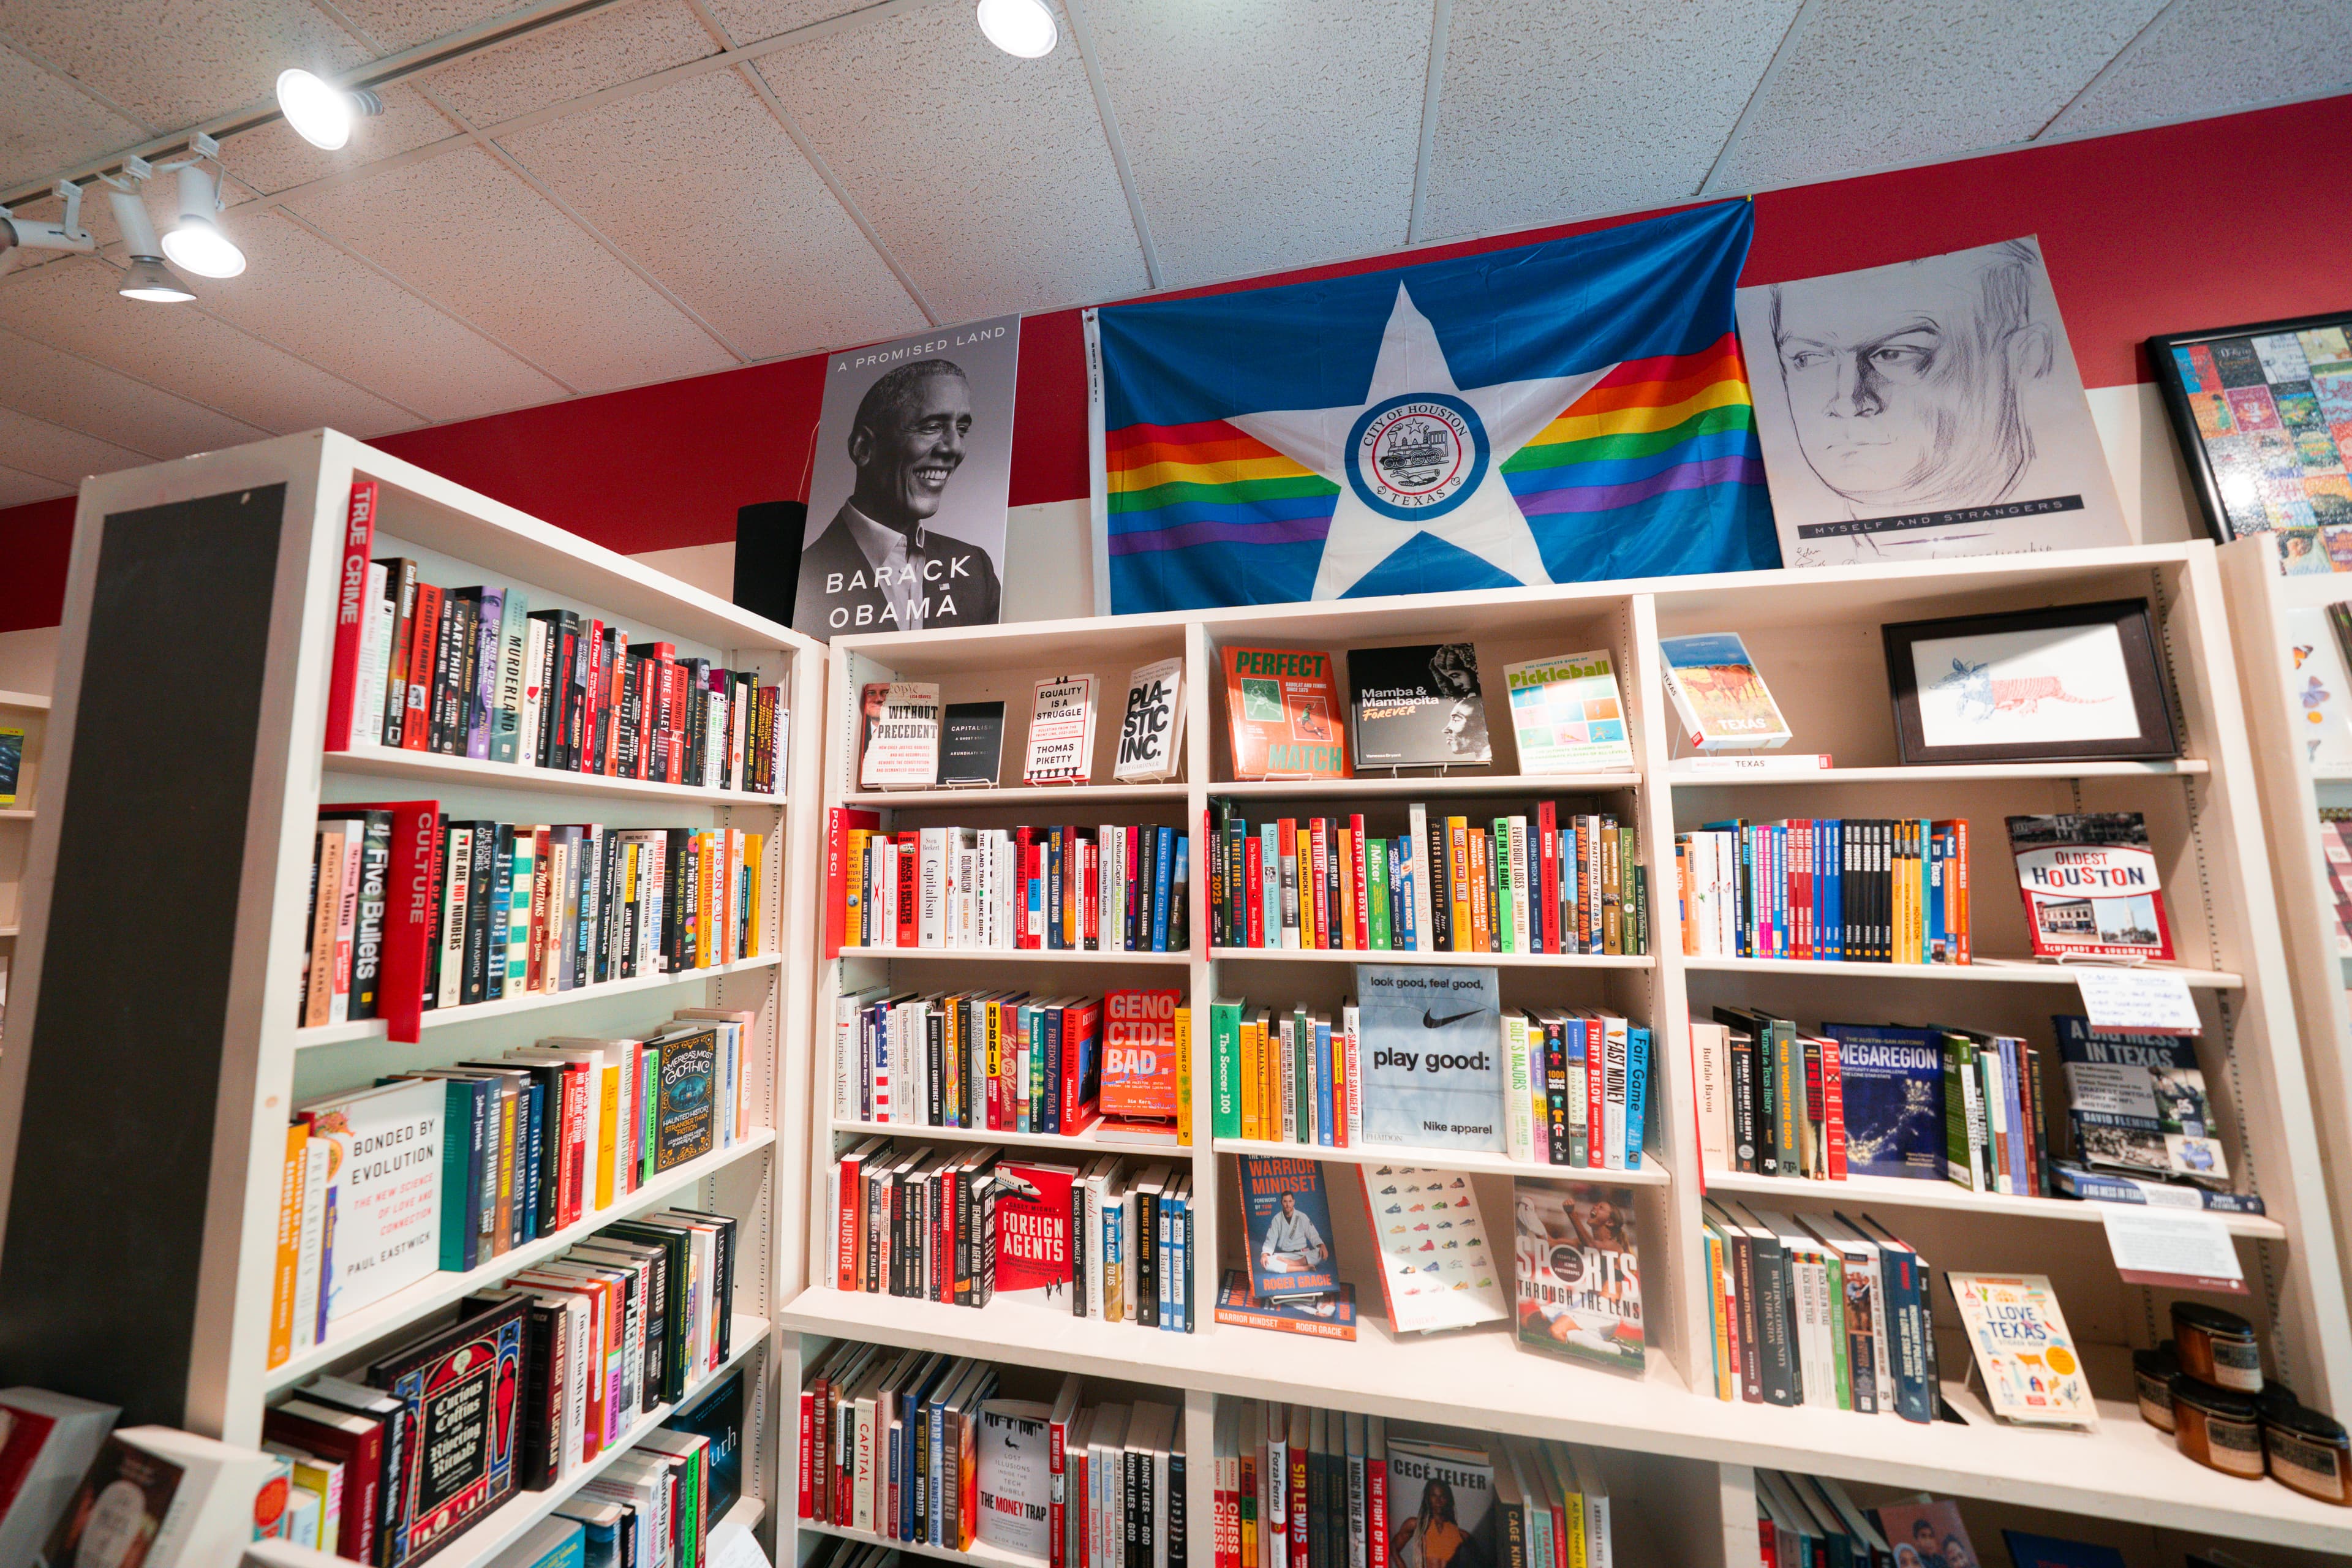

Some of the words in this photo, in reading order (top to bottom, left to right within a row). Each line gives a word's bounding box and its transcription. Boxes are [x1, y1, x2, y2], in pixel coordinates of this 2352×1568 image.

[837, 362, 848, 372] A
[856, 339, 948, 368] PROMISED
[956, 326, 1005, 346] LAND
[1363, 419, 1386, 447] CITY
[1387, 409, 1403, 420] OF
[1408, 405, 1468, 437] HOUSTON
[1390, 489, 1446, 506] TEXAS
[349, 487, 371, 547] TRUE
[1815, 521, 1883, 535] MYSELF
[1896, 516, 1931, 526] AND
[1943, 500, 2064, 522] STRANGERS
[826, 555, 971, 594] BARACK
[340, 554, 364, 626] CRIME
[829, 594, 957, 628] OBAMA
[1235, 651, 1325, 677] PERFECT
[1509, 660, 1610, 688] Pickleball
[502, 635, 522, 733] MURDERLAND
[662, 669, 673, 699] BONE
[1039, 686, 1082, 699] EQUALITY
[1127, 680, 1172, 714] PLA-
[1362, 687, 1414, 698] Mamba
[1415, 686, 1427, 696] &
[1663, 673, 1677, 696] TEXAS
[889, 706, 938, 720] WITHOUT
[1036, 708, 1082, 720] STRUGGLE
[1362, 695, 1439, 707] Mambacita
[660, 701, 671, 733] VALLEY
[878, 725, 937, 739] PRECEDENT
[1124, 704, 1169, 737] STIC
[1717, 718, 1766, 730] TEXAS
[1036, 755, 1072, 765] PIKETTY
[1037, 744, 1074, 754] THOMAS
[1120, 734, 1161, 764] INC.
[1268, 744, 1343, 771] MATCH
[1512, 827, 1524, 865] EVERYBODY
[363, 848, 388, 896] Five
[409, 813, 432, 924] CULTURE
[961, 856, 971, 893] COLONIALISM
[1232, 864, 1241, 887] KINGS
[1357, 867, 1363, 878] OF
[1370, 849, 1382, 882] Mixer
[1513, 869, 1525, 889] LOSES
[923, 860, 938, 919] Capitalism
[1212, 875, 1222, 905] 2025
[356, 902, 385, 979] Bullets
[1370, 977, 1393, 986] look
[1396, 978, 1427, 989] good,
[1430, 979, 1449, 989] feel
[1453, 980, 1483, 990] good,
[1109, 995, 1175, 1019] GENO
[1108, 1022, 1174, 1047] CIDE
[1219, 1033, 1229, 1054] The
[1589, 1028, 1600, 1065] THIRTY
[697, 1050, 713, 1059] MOST
[838, 1033, 846, 1070] Furious
[1348, 1034, 1357, 1079] SANCTIONED
[1374, 1047, 1419, 1071] play
[1425, 1051, 1490, 1072] good:
[1607, 1039, 1625, 1065] FAST
[1634, 1038, 1647, 1065] Fair
[1703, 1048, 1713, 1081] Buffalo
[1839, 1044, 1937, 1069] MEGAREGION
[2085, 1042, 2108, 1062] IN
[2109, 1045, 2174, 1069] TEXAS
[665, 1061, 710, 1085] GOTHIC
[1219, 1055, 1230, 1093] Soccer
[1591, 1069, 1600, 1105] BELOW
[1607, 1067, 1625, 1105] MONEY
[1782, 1065, 1790, 1101] WOMEN
[837, 1073, 846, 1105] Minds
[1349, 1079, 1358, 1116] SAVAGERY
[1630, 1069, 1645, 1112] Game
[1704, 1085, 1713, 1113] Bayou
[1221, 1095, 1231, 1114] 100
[1423, 1121, 1447, 1131] Nike
[1451, 1125, 1492, 1135] apparel
[2083, 1112, 2113, 1125] DAVID
[2114, 1116, 2158, 1129] FLEMING
[353, 1126, 413, 1157] BONDED
[420, 1118, 435, 1136] BY
[1784, 1123, 1792, 1150] GOOD
[352, 1144, 434, 1186] EVOLUTION
[1249, 1159, 1316, 1177] WARRIOR
[1252, 1175, 1316, 1194] MINDSET
[841, 1208, 853, 1270] INJUSTICE
[1003, 1212, 1063, 1238] FOREIGN
[347, 1256, 375, 1276] PAUL
[380, 1231, 431, 1263] EASTWICK
[1003, 1232, 1063, 1262] AGENTS
[1516, 1235, 1639, 1297] SPORTS
[655, 1259, 665, 1313] PROGRESS
[1263, 1276, 1295, 1291] ROGER
[1298, 1275, 1332, 1287] GRACIE
[1518, 1280, 1573, 1306] THROUGH
[1580, 1292, 1602, 1311] THE
[1609, 1297, 1640, 1319] LENS
[1985, 1307, 1992, 1319] I
[1997, 1305, 2035, 1322] LOVE
[637, 1314, 646, 1351] SPACE
[1218, 1312, 1248, 1323] WARRIOR
[1249, 1317, 1278, 1328] MINDSET
[1296, 1322, 1317, 1333] ROGER
[1319, 1325, 1342, 1336] GRACIE
[1986, 1321, 2047, 1341] TEXAS
[435, 1380, 483, 1417] Curious
[435, 1398, 480, 1433] Coffins
[430, 1422, 481, 1462] Riveting
[859, 1423, 869, 1483] CAPITAL
[432, 1441, 476, 1479] Rituals
[1393, 1458, 1432, 1479] CECÉ
[1434, 1467, 1487, 1491] TELFER
[980, 1491, 994, 1510] THE
[995, 1496, 1023, 1518] MONEY
[1025, 1503, 1046, 1522] TRAP
[1227, 1502, 1240, 1555] CHESS
